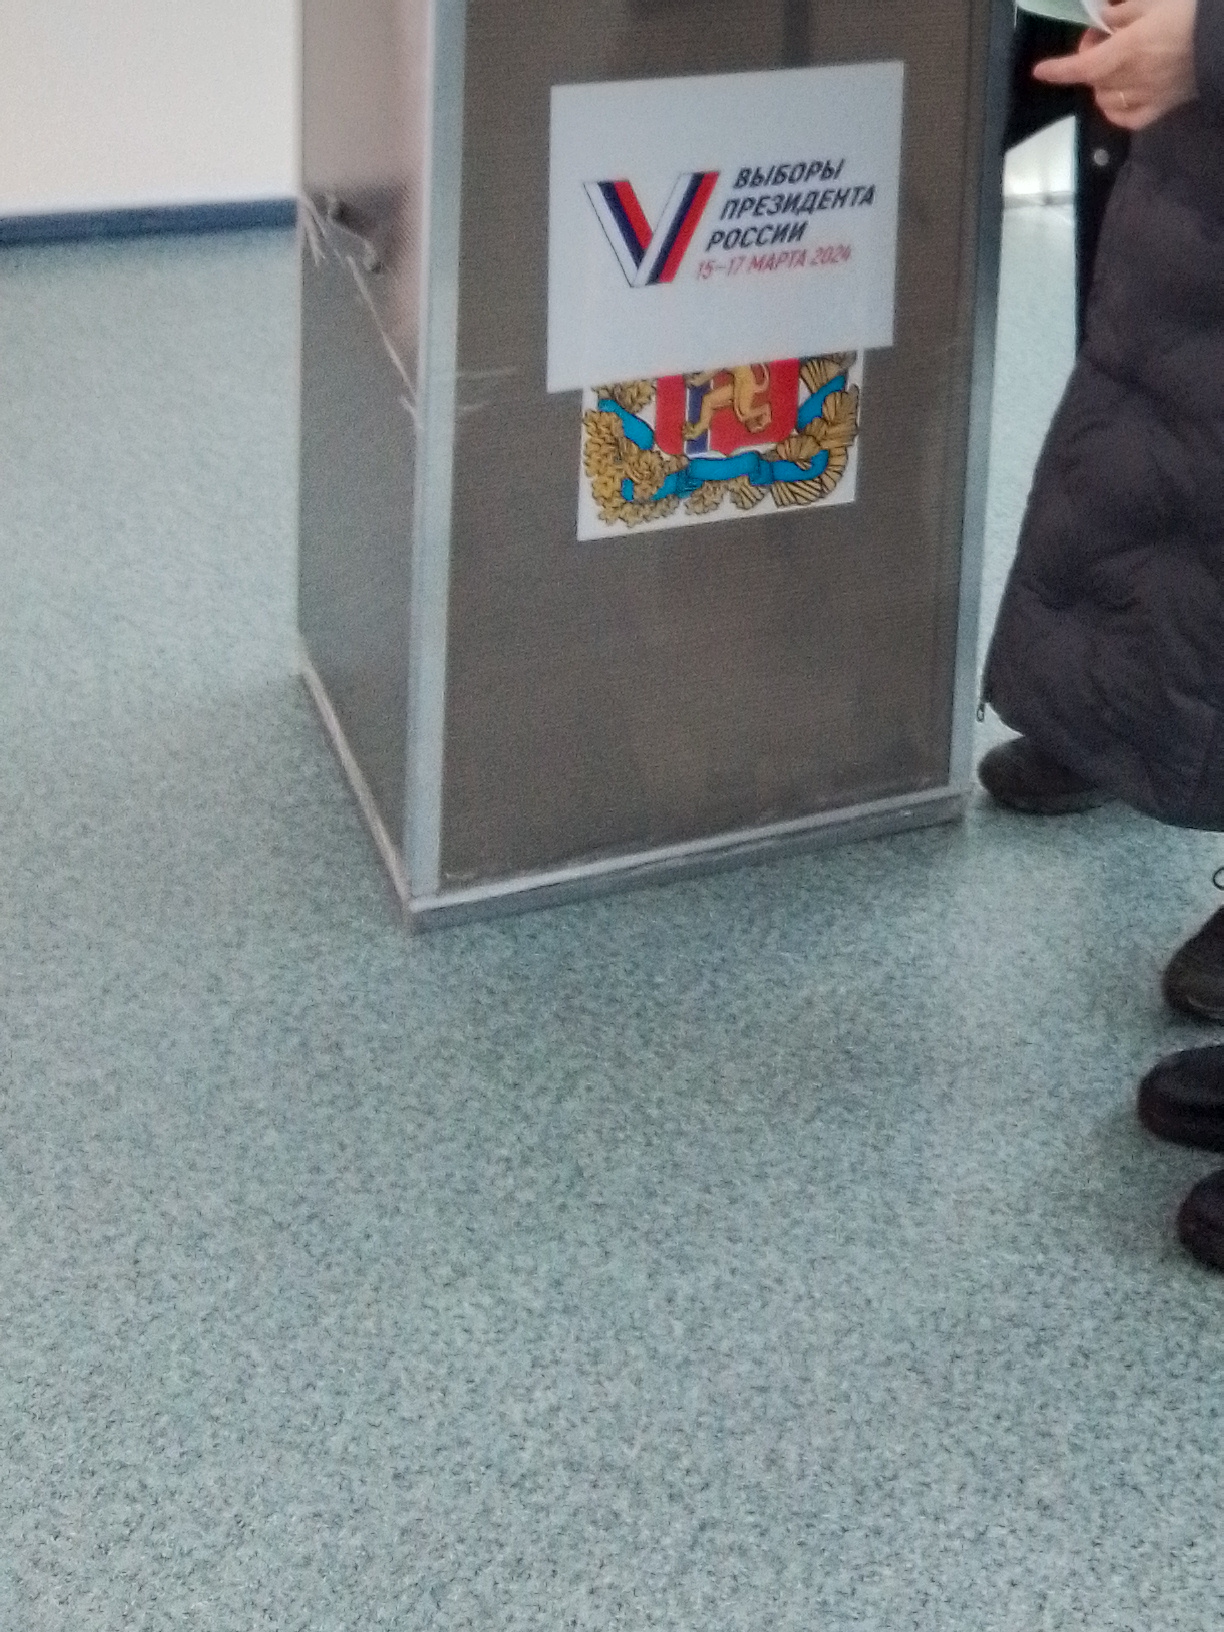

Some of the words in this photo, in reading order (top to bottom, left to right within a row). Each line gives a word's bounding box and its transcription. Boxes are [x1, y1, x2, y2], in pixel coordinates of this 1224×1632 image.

[733, 158, 846, 189] ВЫБОРЫ
[719, 184, 876, 220] ПРЕЗИДЕНТА
[705, 221, 809, 252] РОССИИ
[748, 249, 808, 272] МАРТА
[810, 244, 852, 266] 2024
